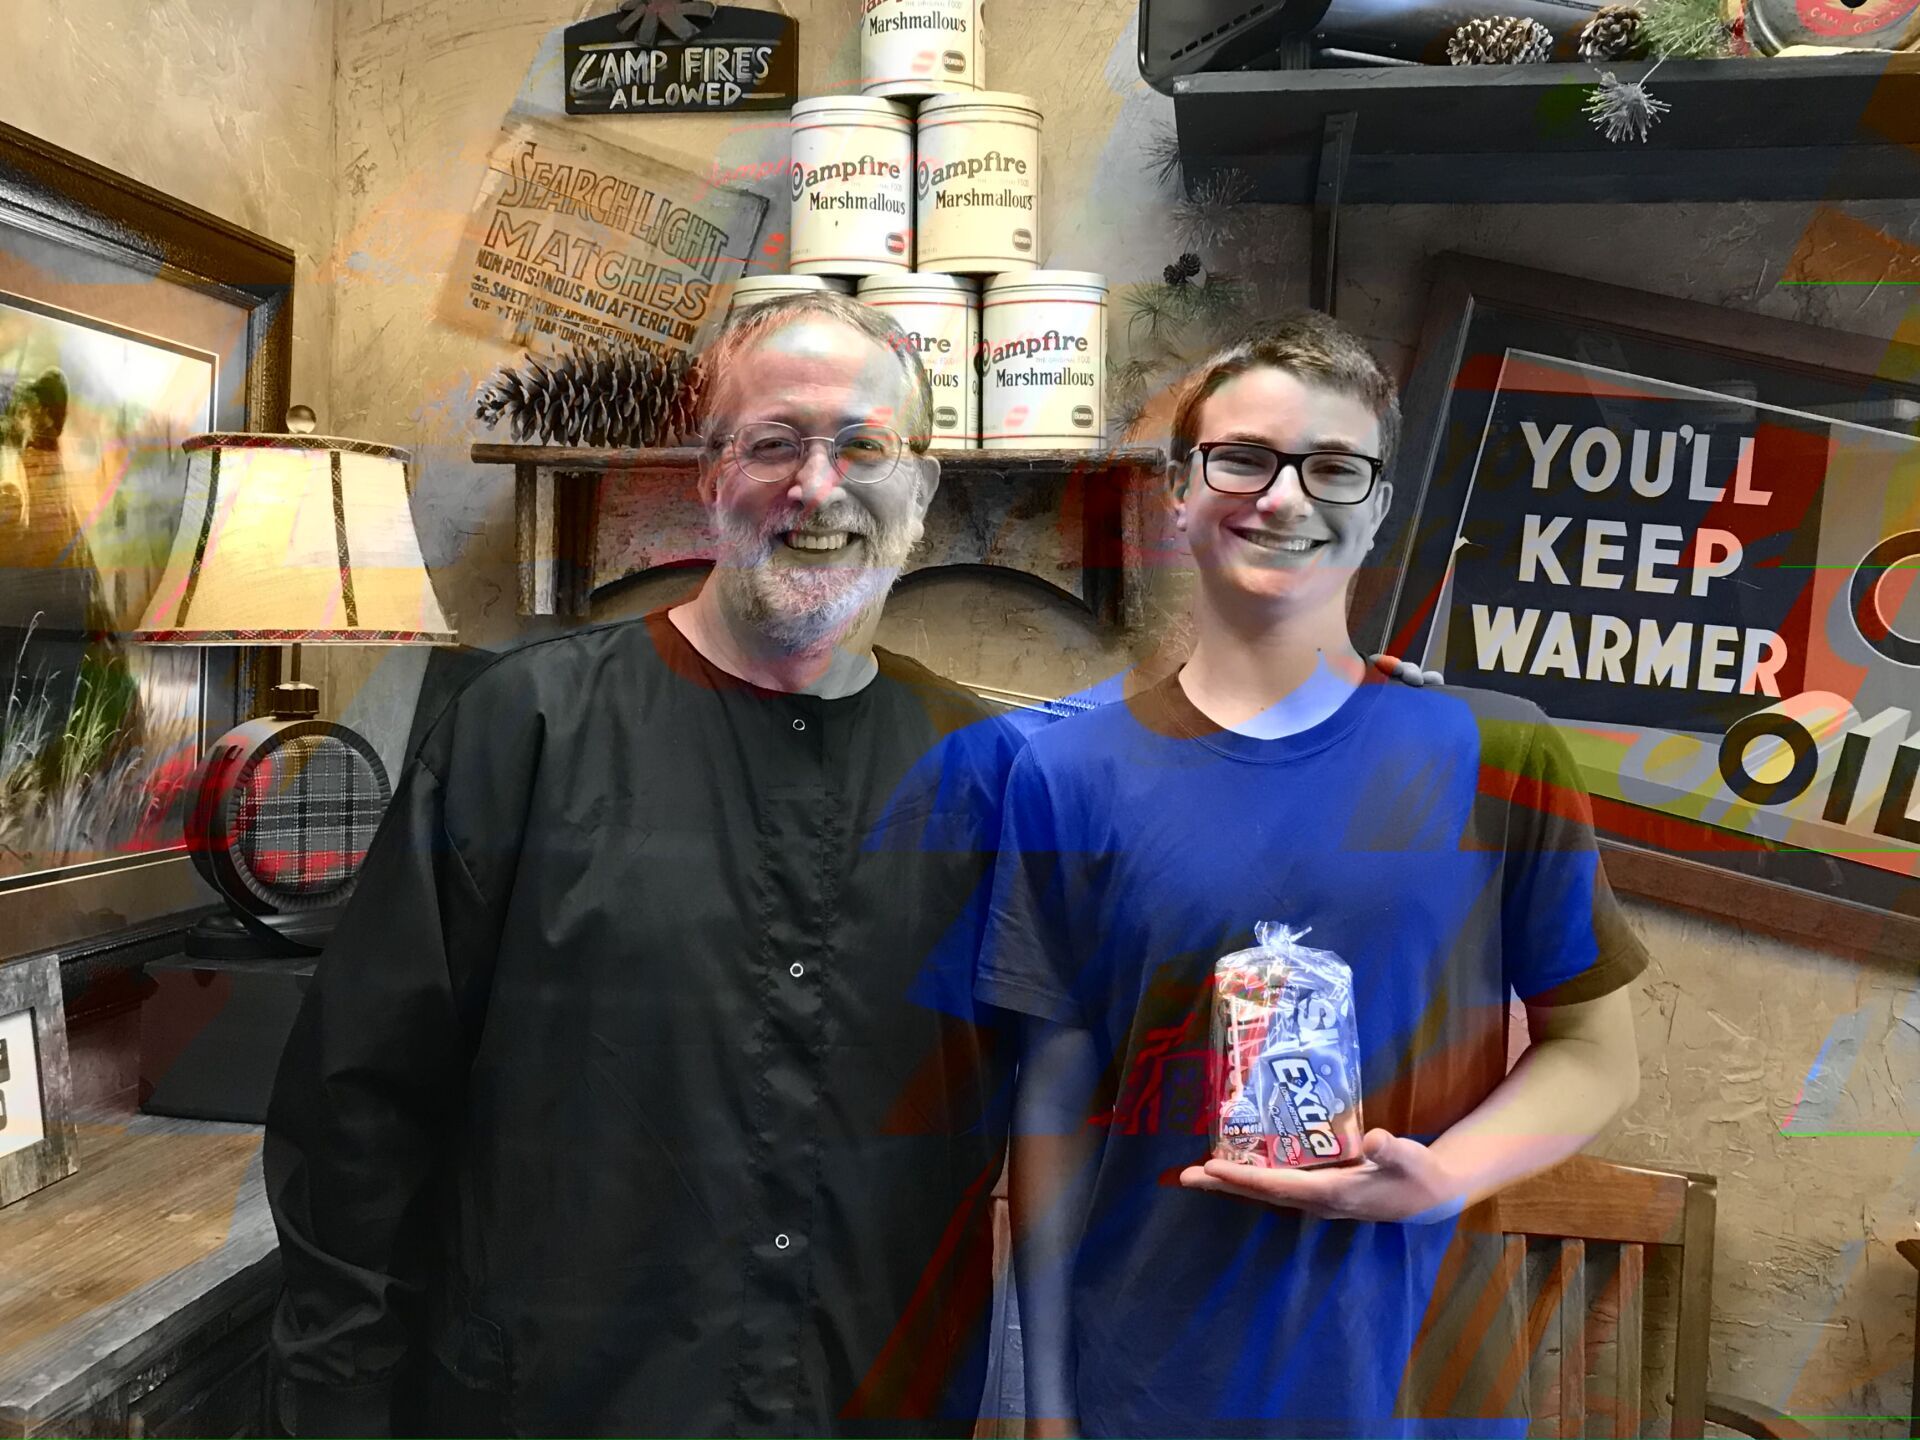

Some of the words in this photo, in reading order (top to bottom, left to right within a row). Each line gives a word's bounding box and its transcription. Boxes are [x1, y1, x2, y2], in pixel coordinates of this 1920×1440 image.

[869, 11, 966, 36] Marshmallows
[570, 50, 667, 97] CAMP
[681, 47, 772, 86] FIRES
[609, 82, 742, 109] ALLOWED
[791, 154, 901, 202] Campfire
[917, 150, 1027, 201] Campfire
[935, 187, 1033, 211] Marshmallows
[497, 141, 729, 282] SEARCHLIGHT
[809, 190, 906, 215] Marshmallows
[484, 209, 711, 322] MATCHES
[475, 247, 503, 274] NON
[501, 257, 585, 303] POISONOUS
[583, 288, 608, 312] NO
[605, 297, 698, 345] AFTERGLOW
[982, 330, 1089, 377] Campfire
[996, 367, 1095, 388] Marshmallows
[1520, 421, 1773, 506] YOU'LL
[1518, 513, 1743, 597] KEEP
[1471, 604, 1788, 698] WARMER
[1269, 1057, 1341, 1158] Extra
